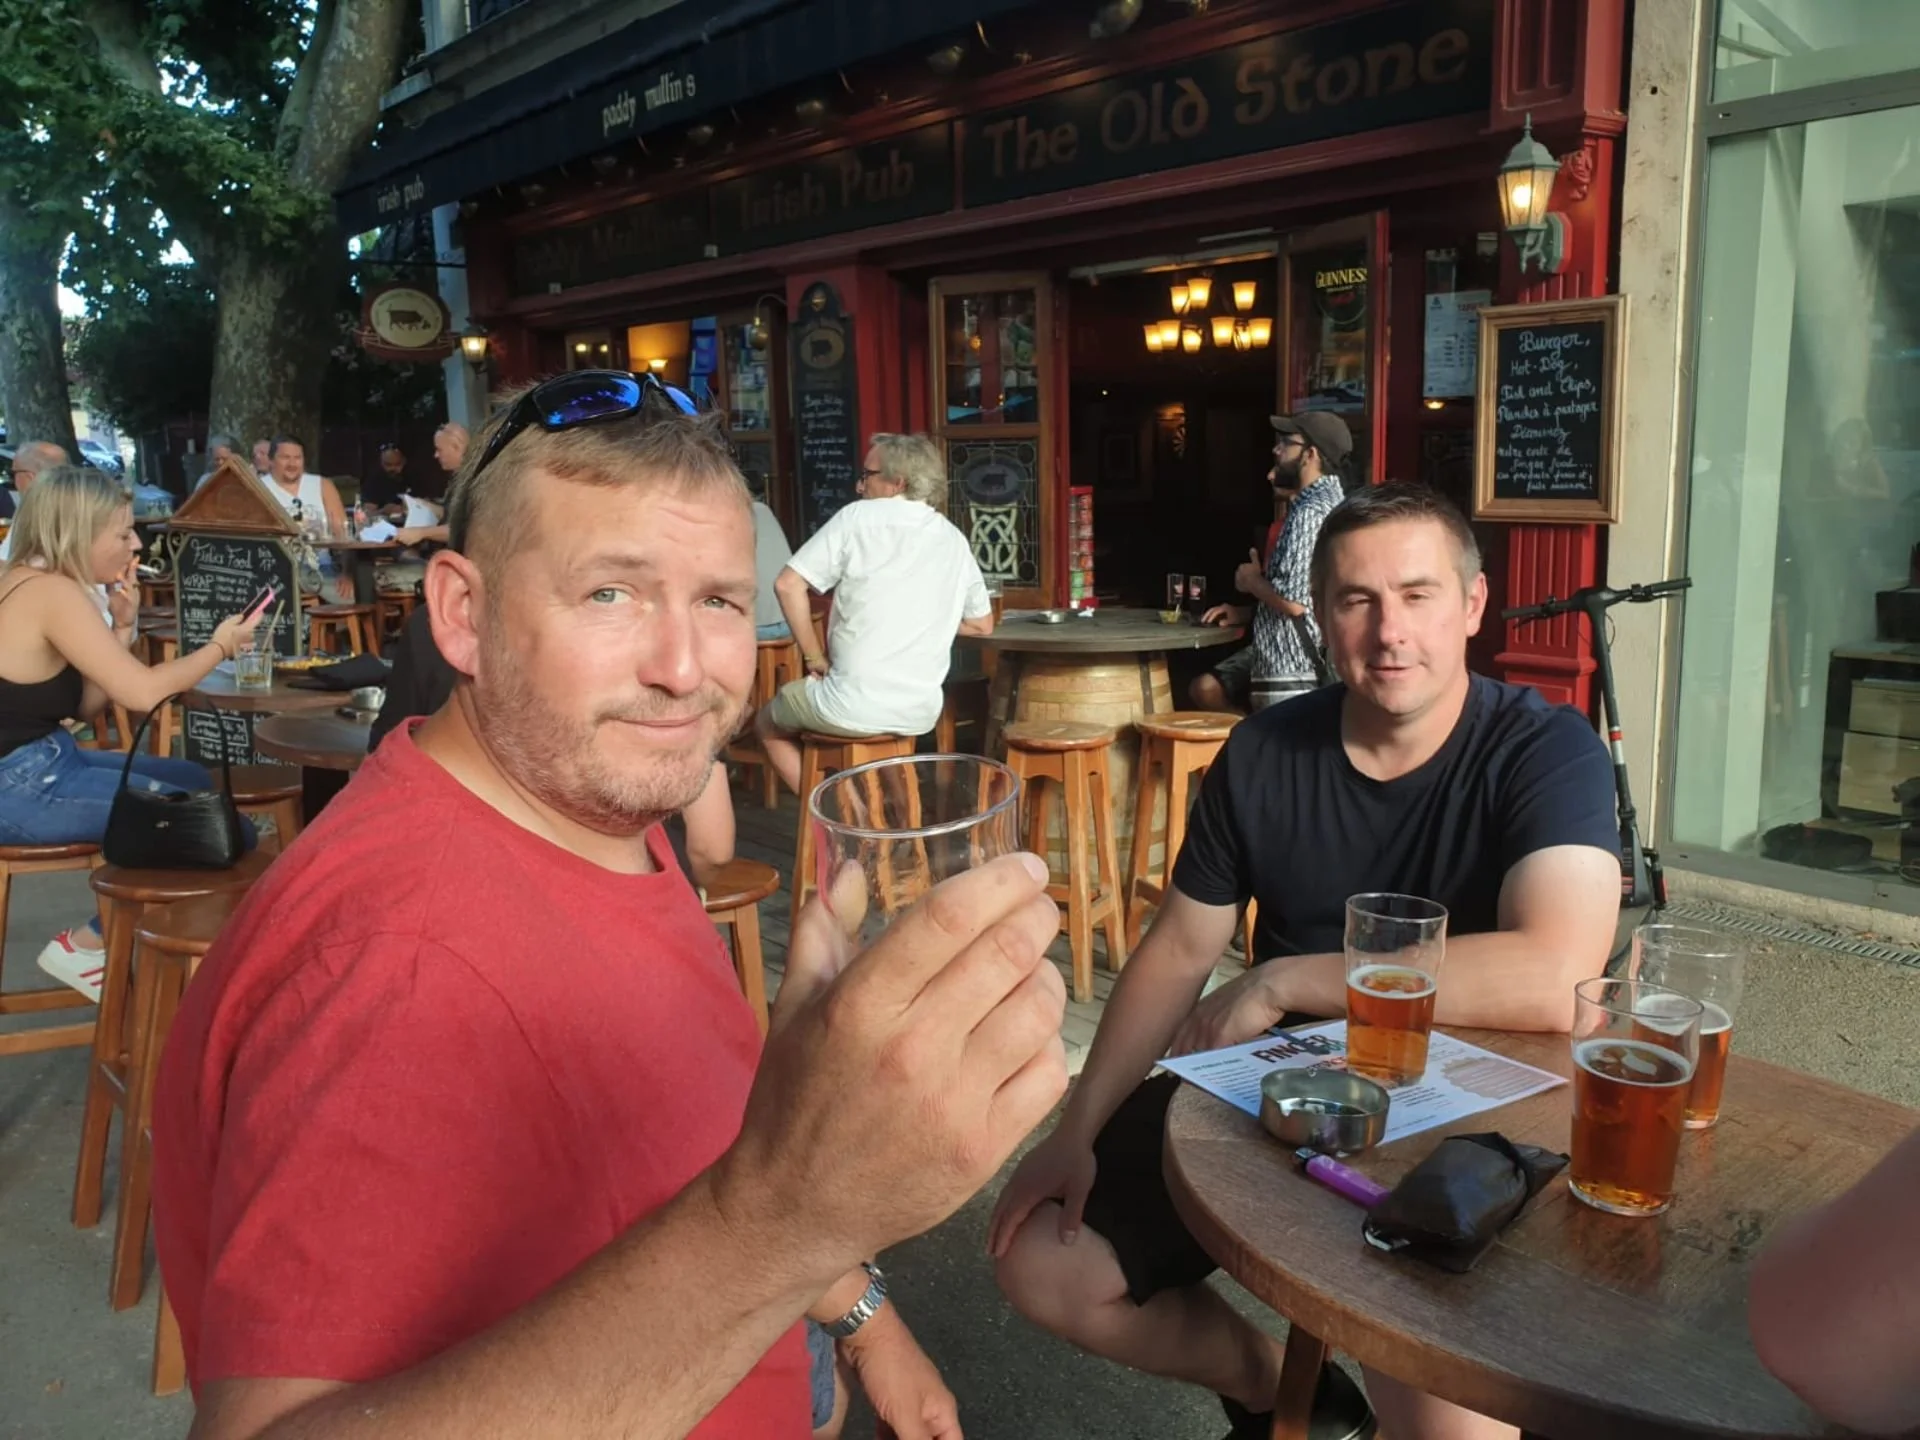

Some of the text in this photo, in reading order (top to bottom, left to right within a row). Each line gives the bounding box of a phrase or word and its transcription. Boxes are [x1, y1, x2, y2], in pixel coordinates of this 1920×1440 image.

[602, 89, 637, 138] paddy
[982, 27, 1469, 178] The Old Stone
[377, 173, 425, 214] irish pub
[738, 148, 916, 234] Irish Pub
[1528, 381, 1554, 399] and
[224, 545, 253, 569] Food
